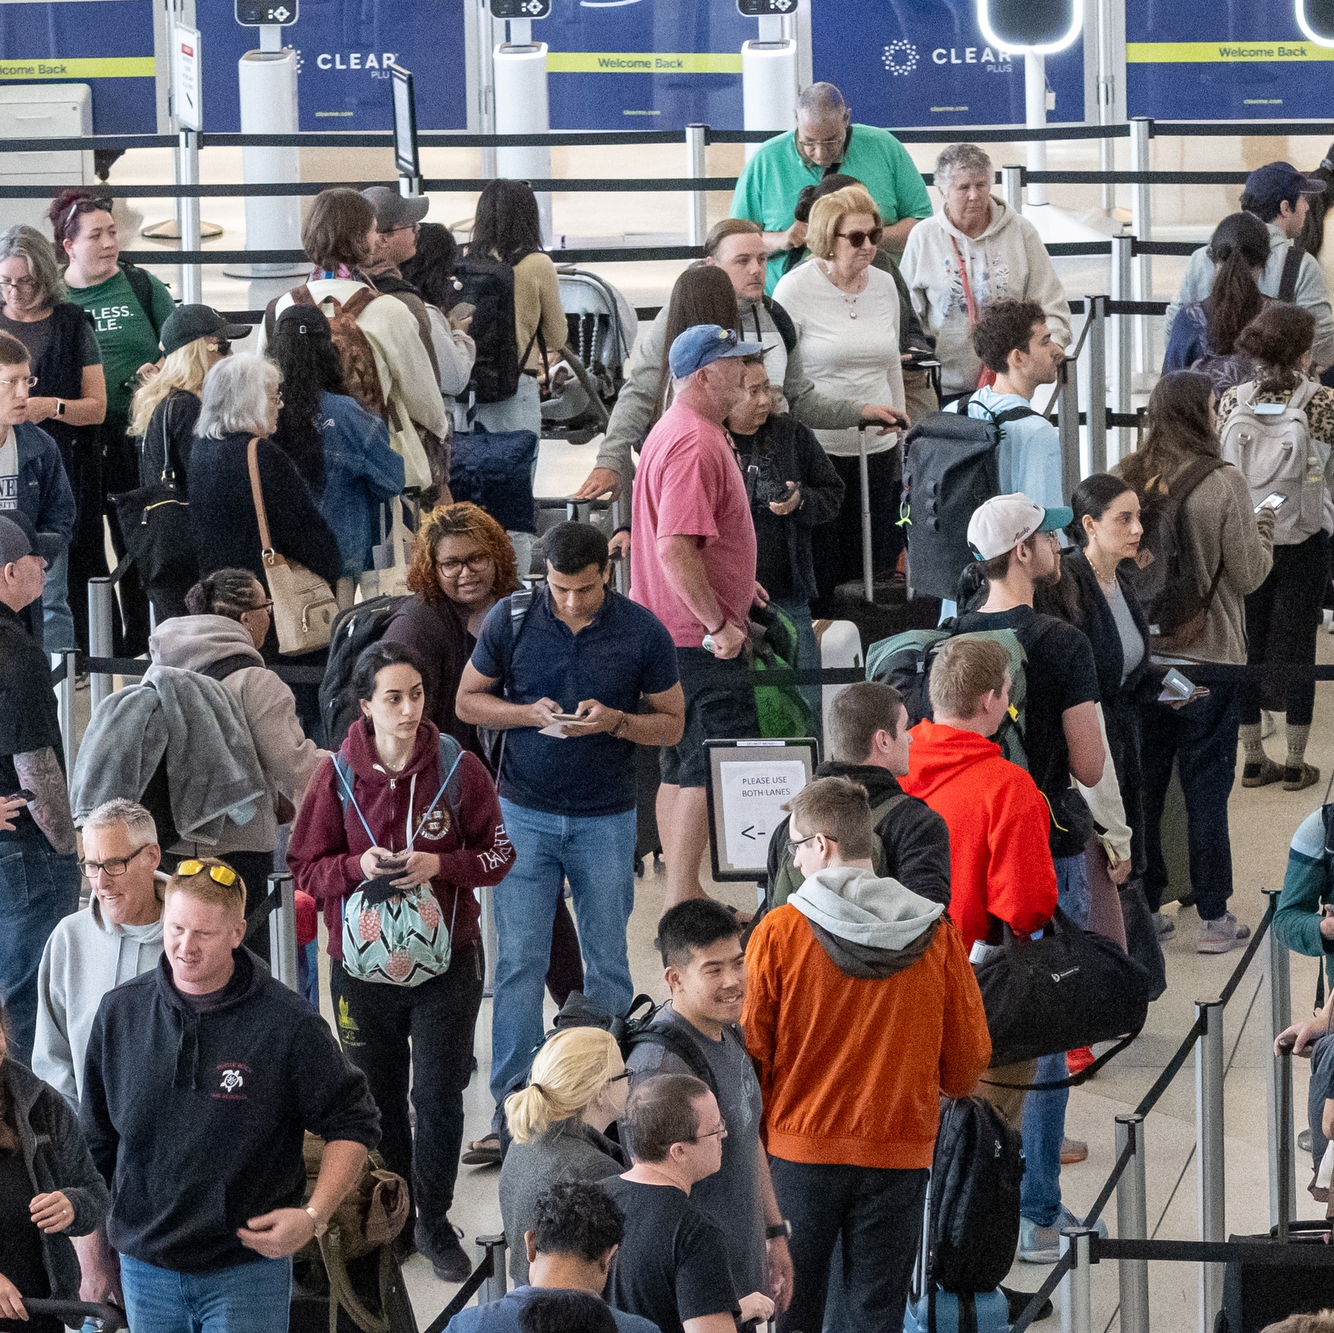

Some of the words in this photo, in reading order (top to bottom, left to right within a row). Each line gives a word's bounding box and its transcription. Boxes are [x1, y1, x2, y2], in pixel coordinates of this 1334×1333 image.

[932, 47, 1012, 65] CLEAR
[1219, 47, 1274, 57] Welcome
[1277, 46, 1307, 57] Back
[316, 53, 396, 70] CLEAR
[598, 58, 652, 69] Welcome
[655, 58, 683, 69] Back
[38, 64, 67, 75] Back
[986, 64, 1013, 73] PLUS
[370, 71, 389, 79] PLU
[84, 305, 135, 320] LESS.
[742, 777, 770, 785] PLEASE
[772, 776, 787, 784] USE
[742, 789, 763, 798] BOTH
[765, 788, 790, 797] LANES
